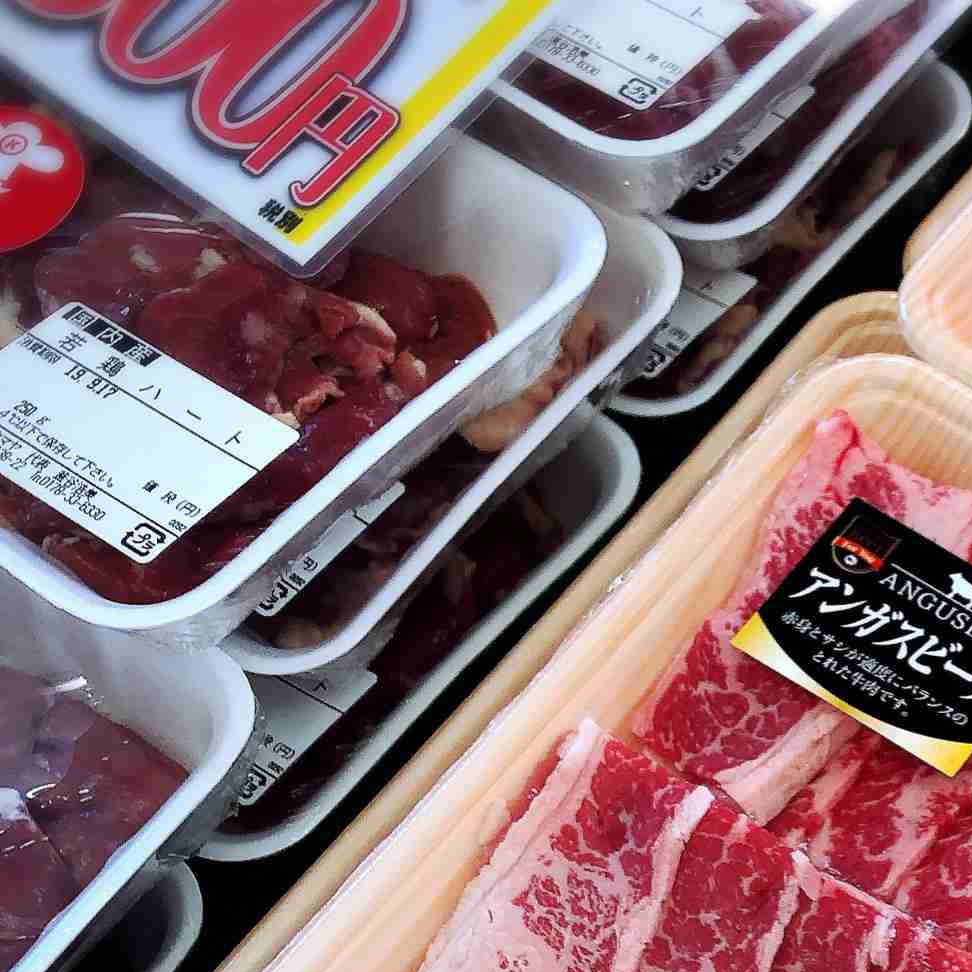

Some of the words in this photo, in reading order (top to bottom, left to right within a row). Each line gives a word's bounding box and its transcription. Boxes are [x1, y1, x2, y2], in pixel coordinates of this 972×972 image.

[779, 610, 970, 727] 赤身とサシが適度にバランスの
[810, 650, 911, 719] とれた牛肉です。
